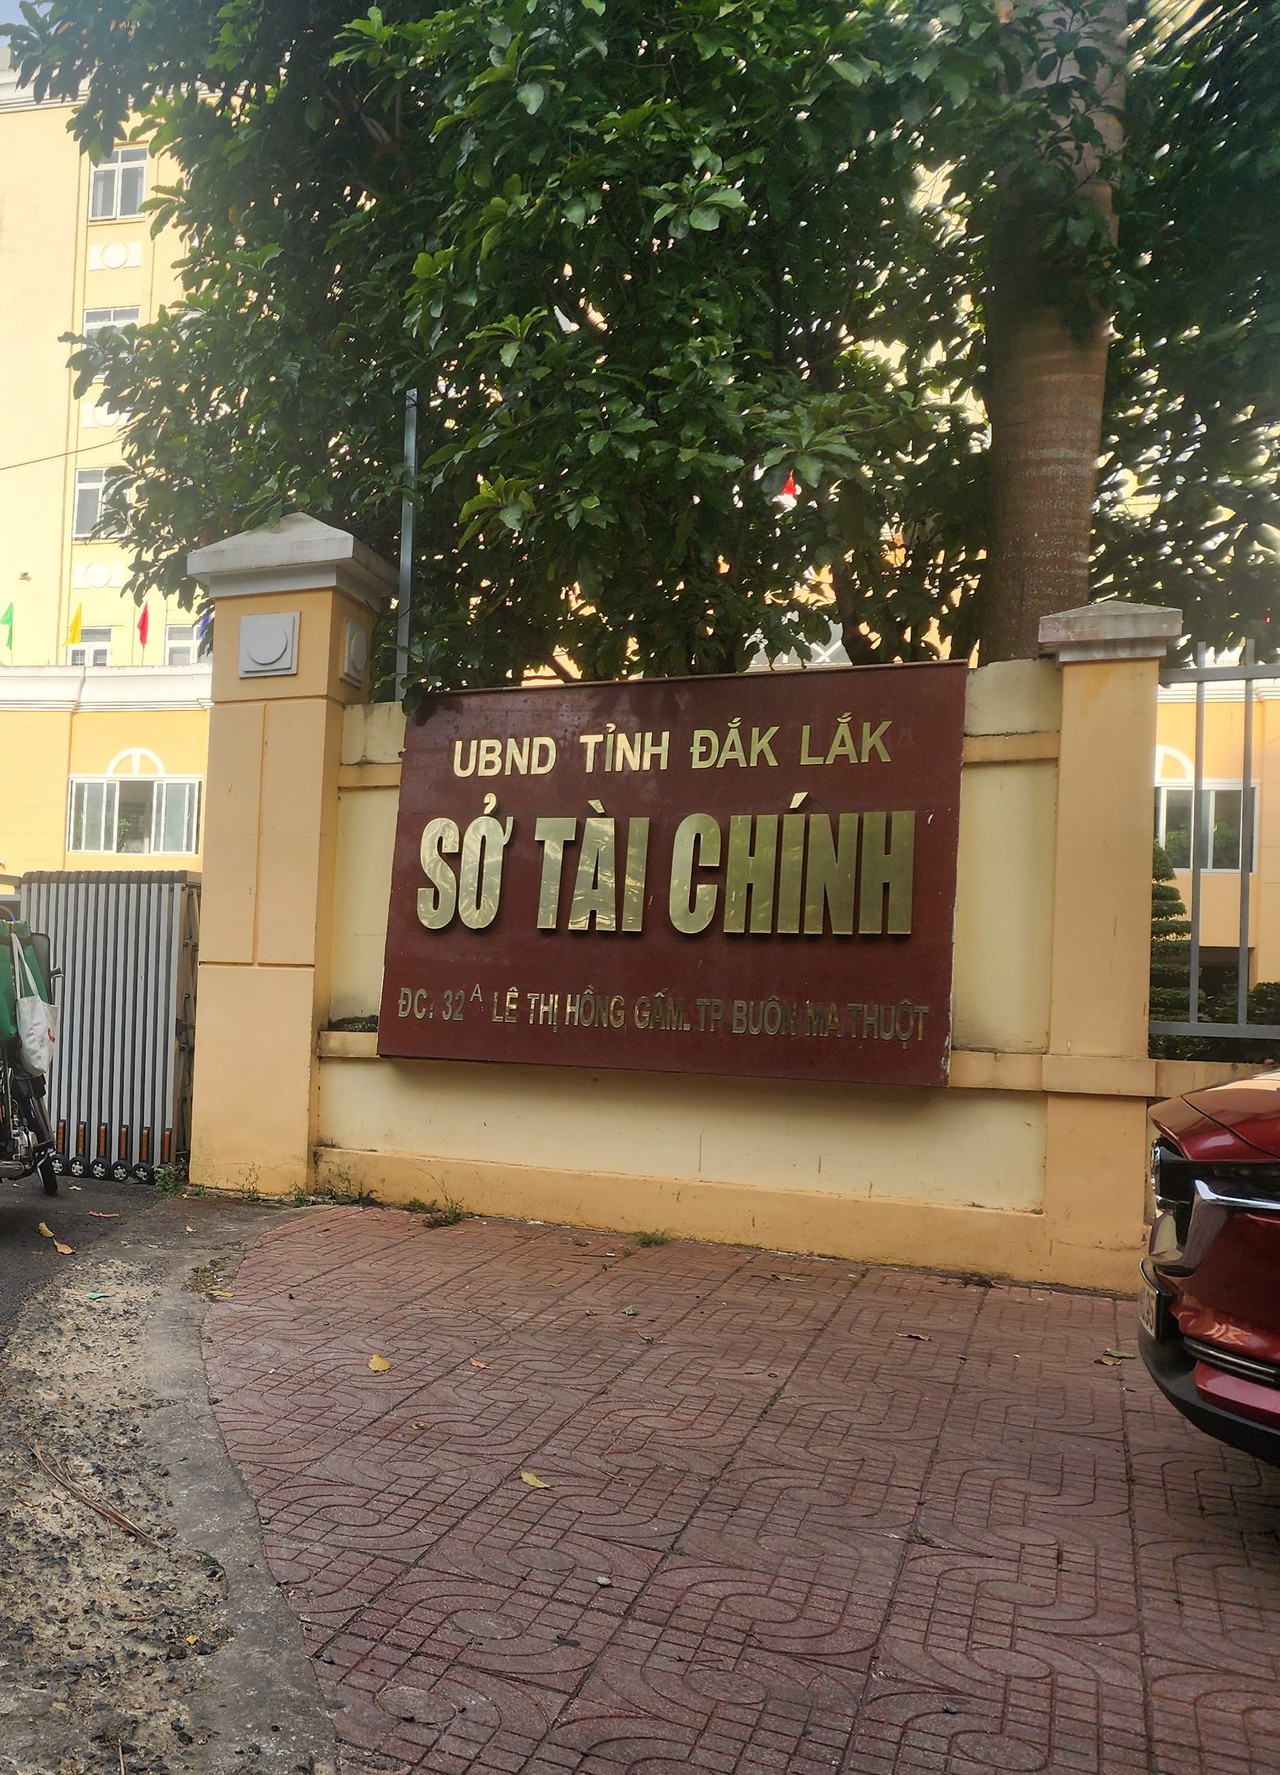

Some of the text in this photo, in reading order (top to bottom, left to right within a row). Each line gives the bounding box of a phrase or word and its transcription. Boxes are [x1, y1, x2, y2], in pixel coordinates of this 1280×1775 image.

[453, 711, 893, 778] UBND TỈNH ĐẮK LẮK
[417, 791, 916, 935] SỞ TÀI CHÍNH
[398, 987, 434, 1020] ĐC:
[492, 986, 519, 1023] LÊ
[526, 992, 559, 1033] THỊ
[564, 984, 625, 1028] HỒNG
[696, 998, 724, 1032] TP
[732, 995, 797, 1035] BUÔN
[805, 1001, 842, 1037] MA
[847, 999, 929, 1049] THUỘT
